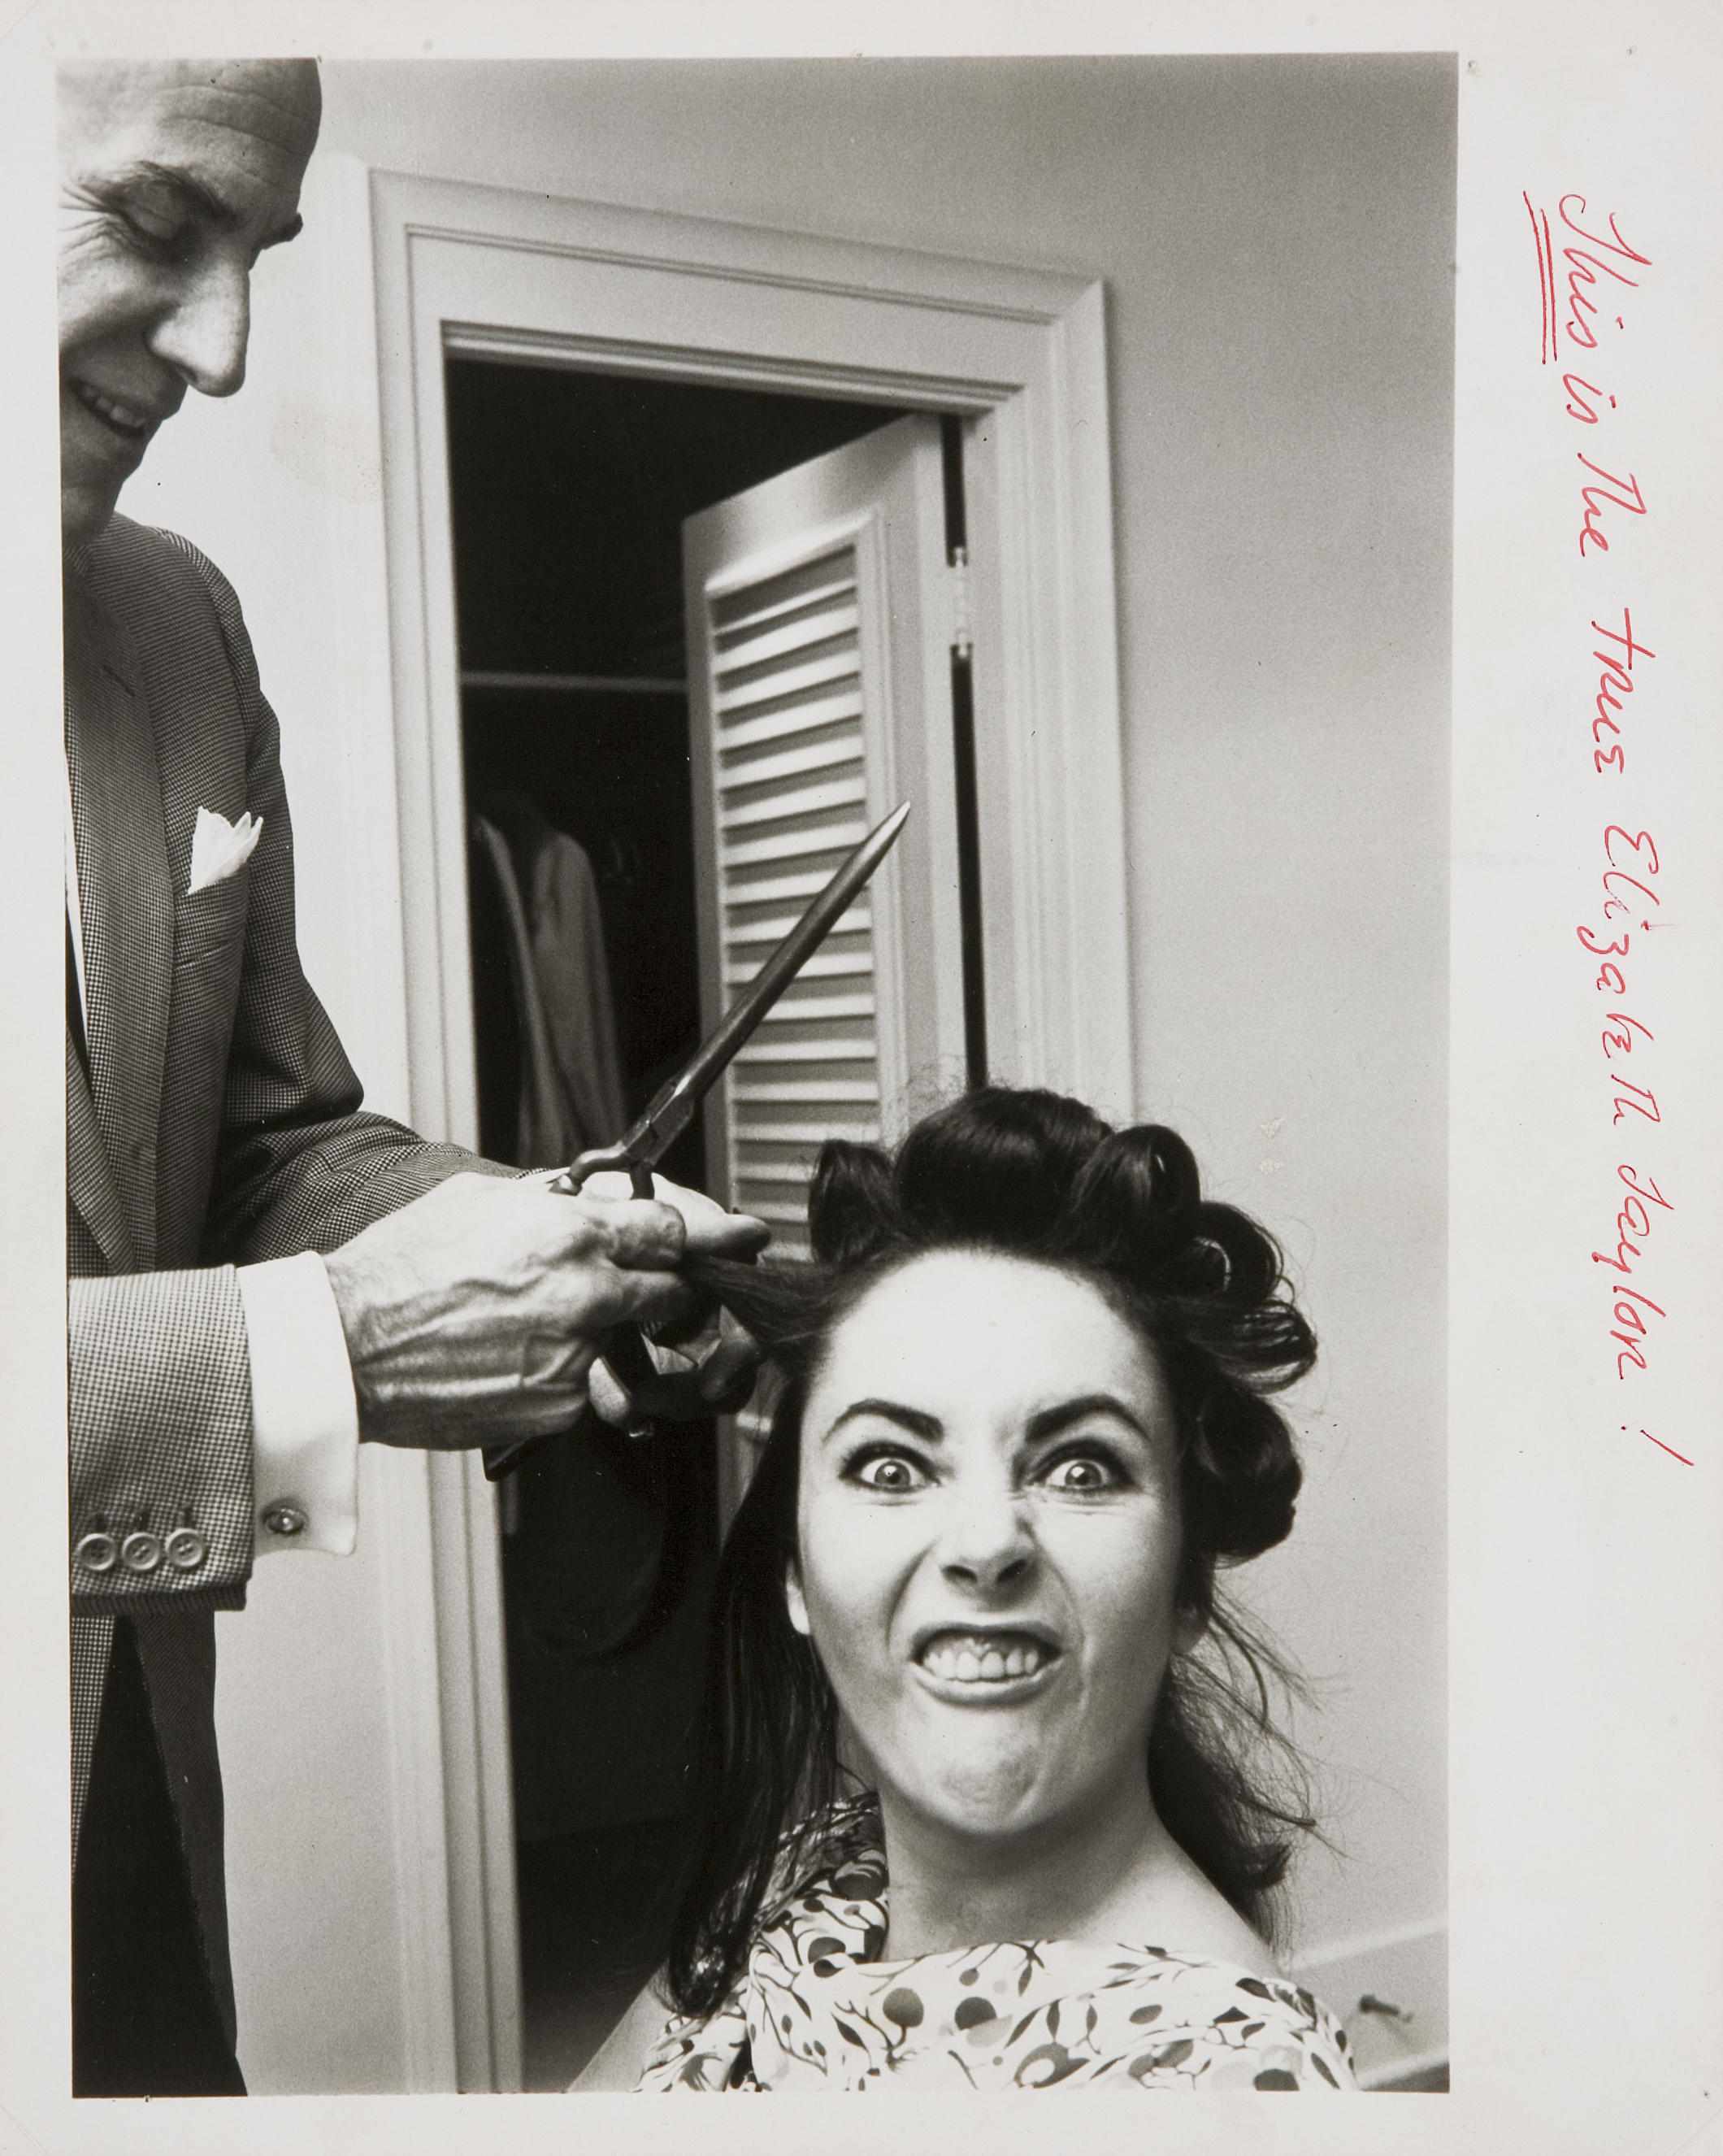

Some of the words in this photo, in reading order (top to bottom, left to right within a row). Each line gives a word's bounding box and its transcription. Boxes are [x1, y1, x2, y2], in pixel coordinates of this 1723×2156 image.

[1557, 195, 1651, 349] This
[1561, 373, 1618, 425] is
[1575, 823, 1664, 1124] Elizabeth
